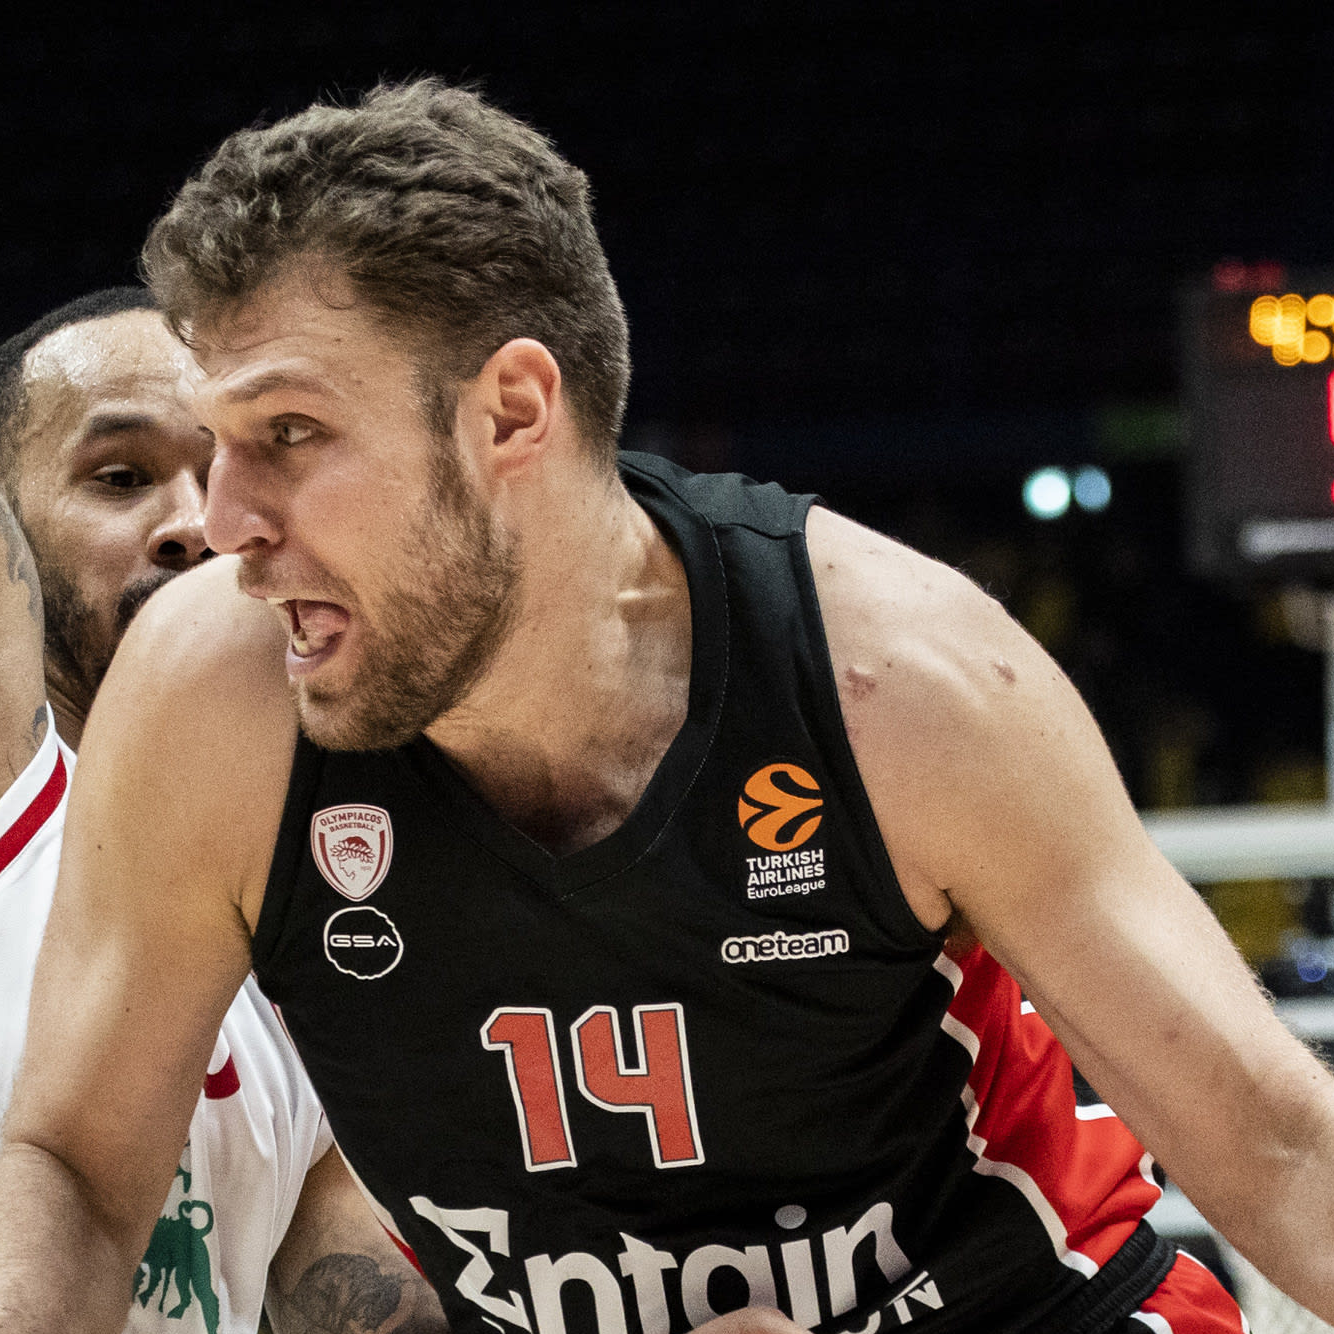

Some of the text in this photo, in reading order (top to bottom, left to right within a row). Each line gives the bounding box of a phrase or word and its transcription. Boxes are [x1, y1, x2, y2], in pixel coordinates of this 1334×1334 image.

[319, 812, 383, 827] OLYMPIACOS
[329, 822, 375, 832] BASKETBALL
[746, 849, 824, 871] TURKISH
[747, 863, 825, 886] AIRLINES
[747, 880, 826, 899] EuroLeague
[329, 934, 397, 947] GSA
[722, 930, 849, 962] oneteam
[480, 1003, 705, 1172] 14
